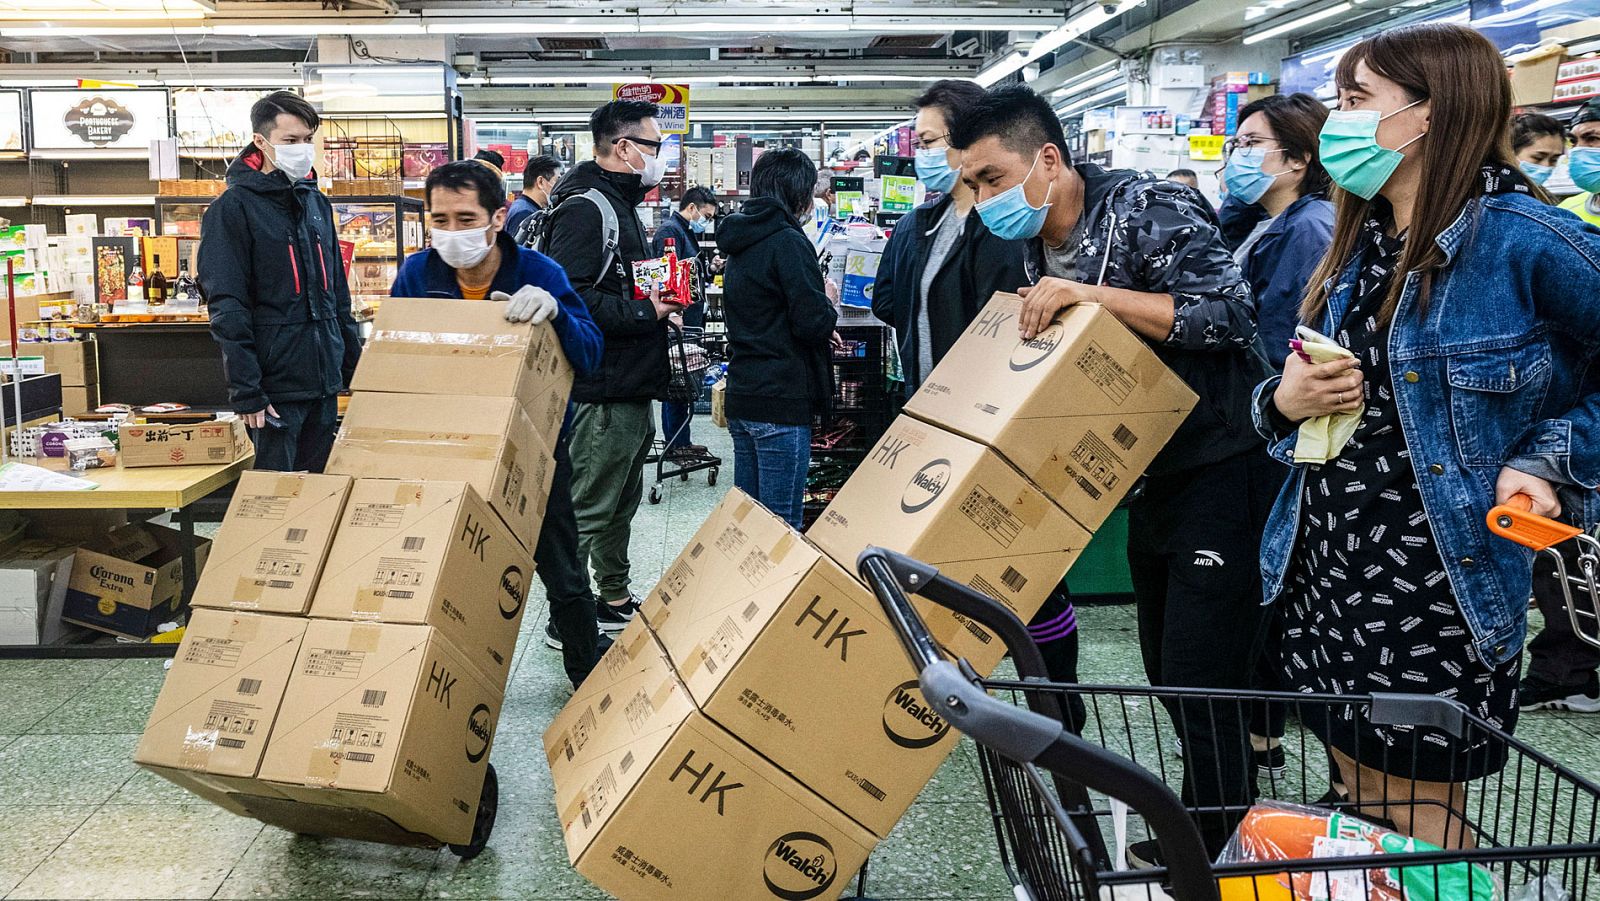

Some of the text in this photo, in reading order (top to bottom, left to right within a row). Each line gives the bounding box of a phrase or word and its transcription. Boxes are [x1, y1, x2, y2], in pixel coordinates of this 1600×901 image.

[88, 126, 112, 136] BAKERY
[969, 309, 1014, 339] HK
[145, 429, 194, 443] 出前一丁
[871, 434, 911, 471] HK
[913, 471, 942, 496] Walch
[460, 513, 491, 563] HK
[1400, 535, 1427, 543] MOSCHINO
[90, 564, 135, 588] Corona
[1193, 557, 1213, 567] ANTA
[502, 577, 521, 605] Walch
[794, 594, 867, 663] HK
[426, 660, 457, 710] HK
[894, 688, 944, 734] Walch
[469, 717, 489, 745] Walch
[668, 749, 745, 817] HK
[774, 839, 828, 887] Walch
